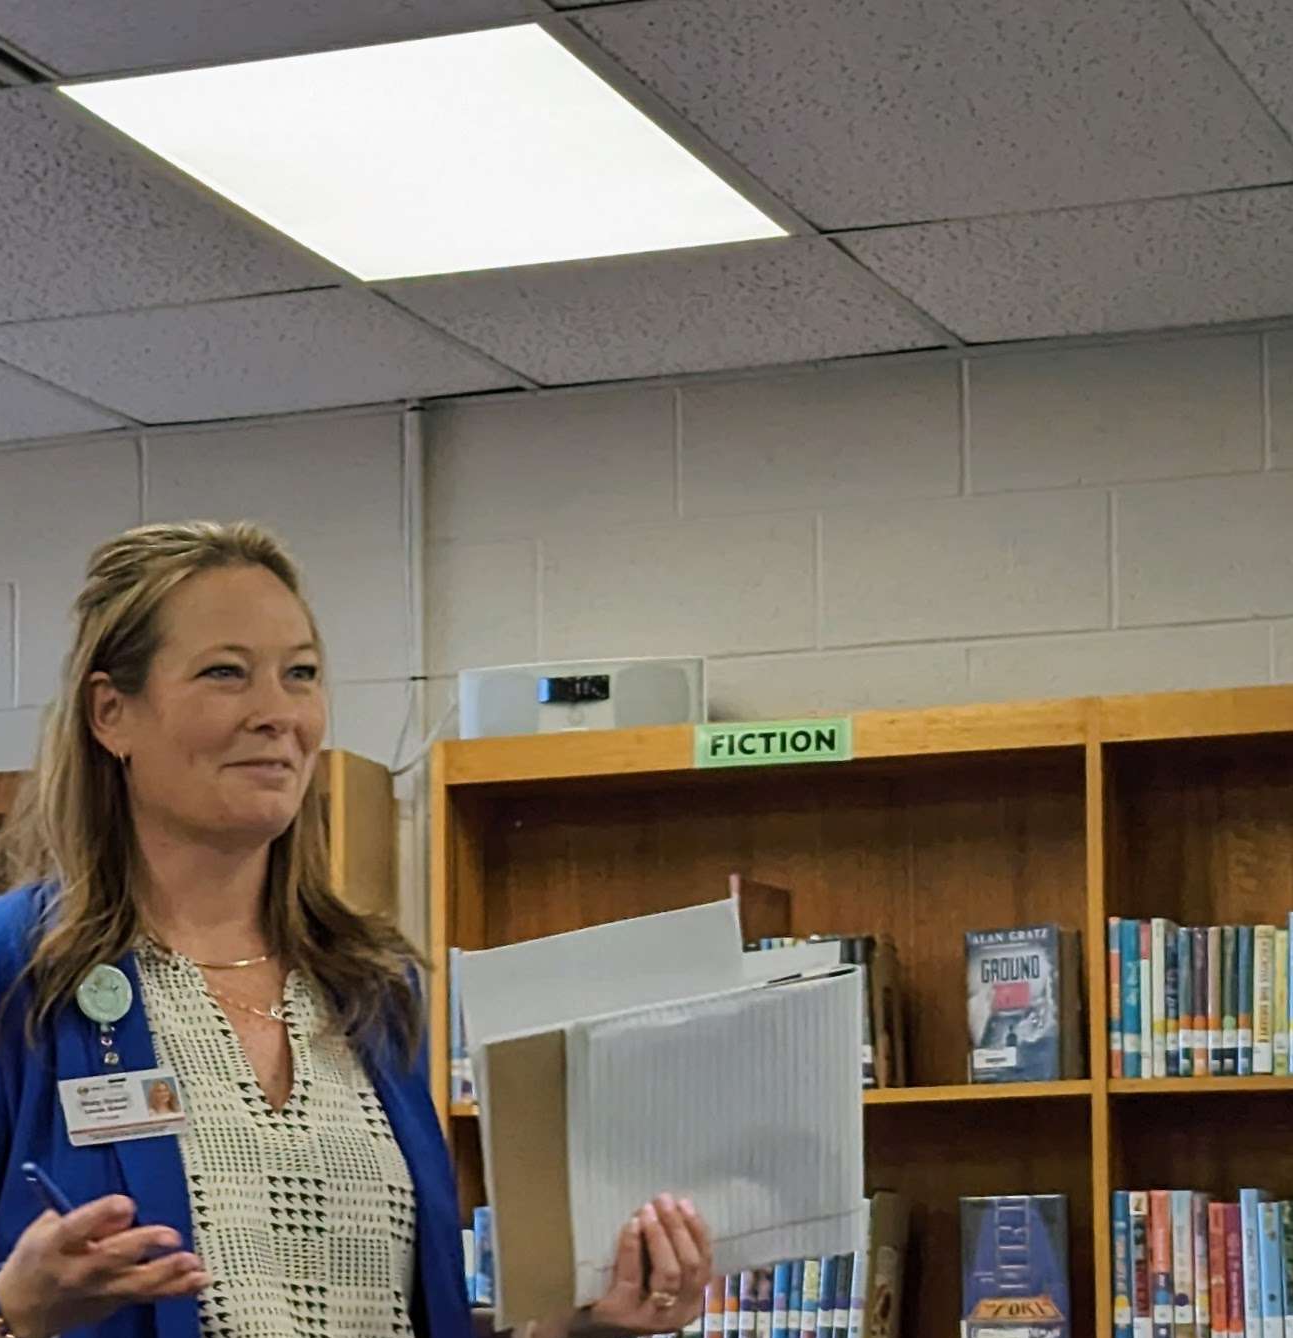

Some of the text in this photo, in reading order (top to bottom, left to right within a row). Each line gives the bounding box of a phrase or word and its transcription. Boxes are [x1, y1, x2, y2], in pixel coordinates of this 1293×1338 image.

[711, 729, 836, 757] FICTION
[973, 931, 1004, 944] ALAN
[981, 955, 1040, 983] GROUND
